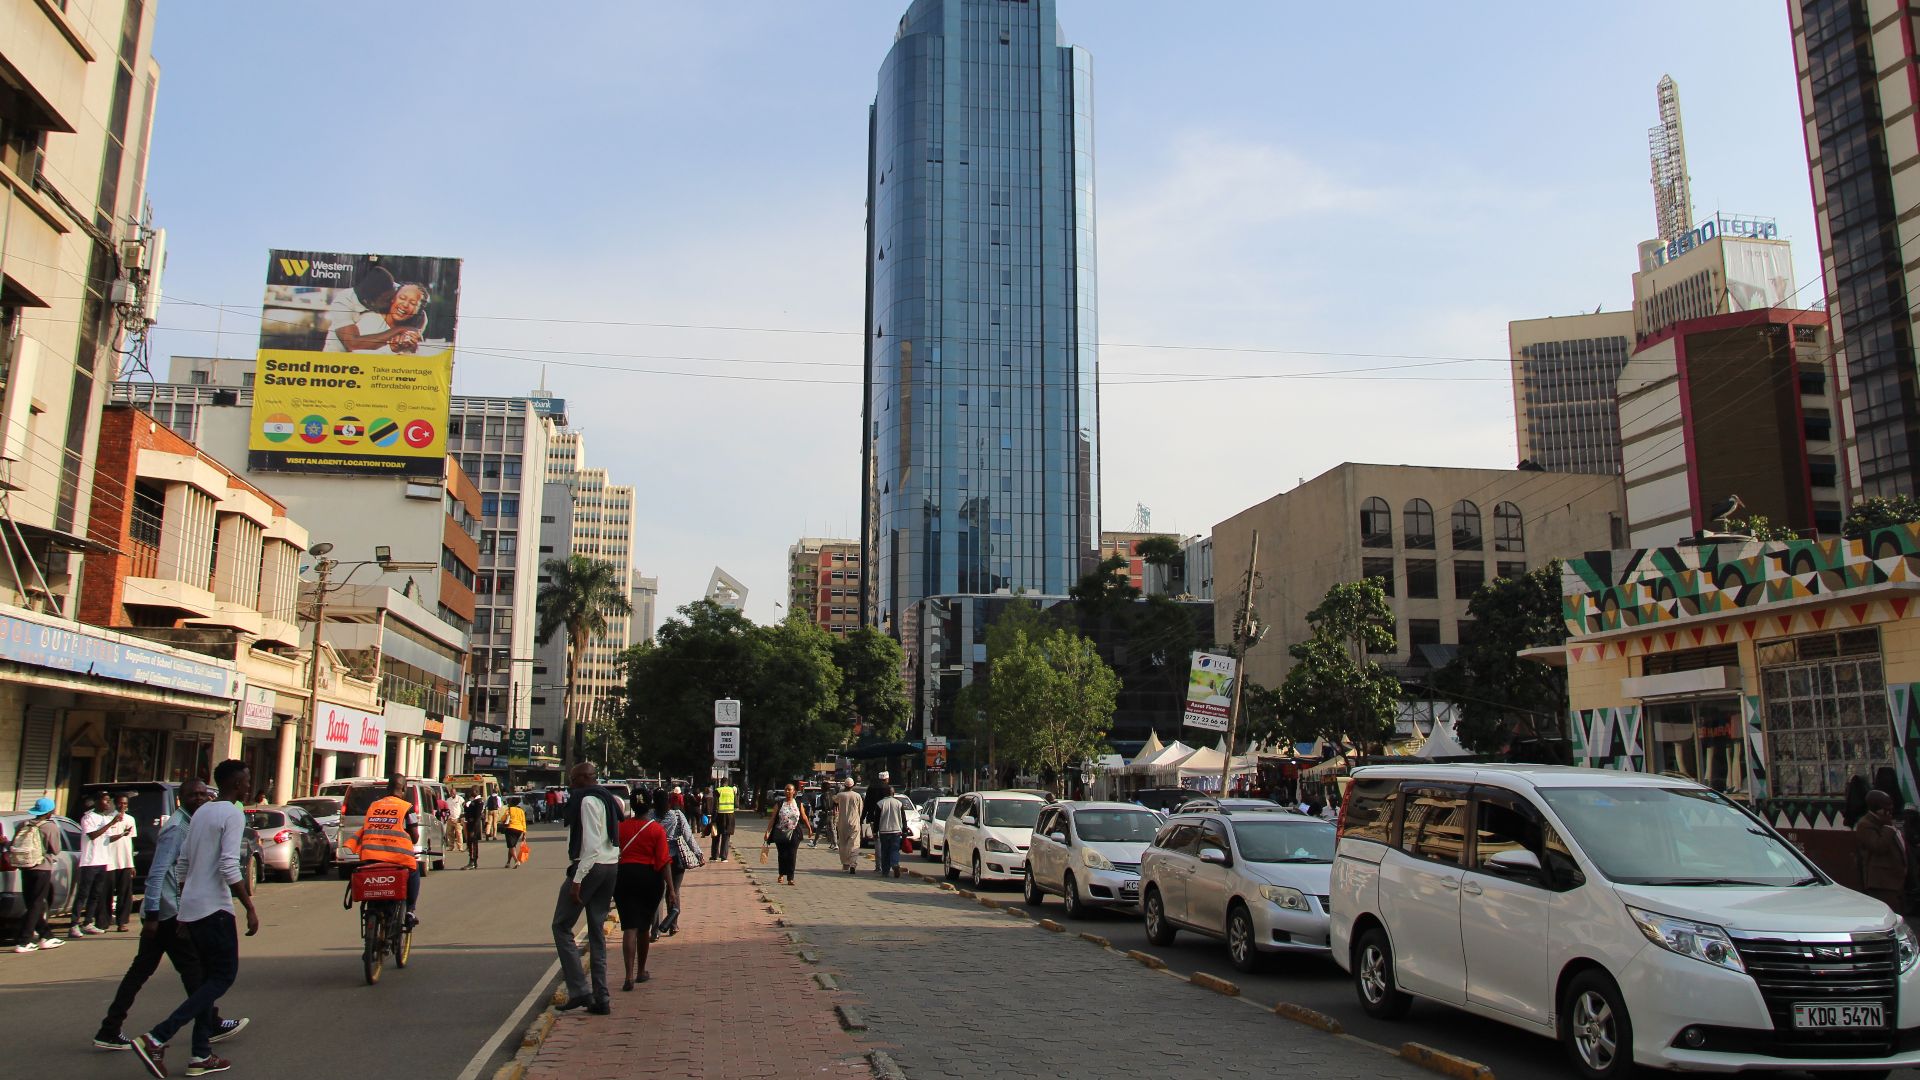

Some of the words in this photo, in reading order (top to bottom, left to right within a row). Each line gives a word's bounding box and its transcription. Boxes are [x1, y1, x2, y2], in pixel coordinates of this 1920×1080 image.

[1655, 220, 1715, 266] TECNO
[312, 260, 353, 271] Western
[311, 269, 340, 279] Union
[265, 359, 311, 373] Send
[313, 363, 364, 375] more.
[391, 368, 432, 376] advantage
[264, 373, 307, 387] Save
[310, 377, 361, 389] more.
[156, 655, 173, 669] School
[1212, 660, 1232, 670] TGL
[1205, 704, 1226, 713] Finance
[326, 709, 350, 744] Bata
[360, 716, 380, 748] Bata
[373, 808, 398, 816] SMS
[364, 876, 395, 884] ANDO
[1808, 1007, 1837, 1026] KDQ
[1842, 1006, 1881, 1026] 547N
